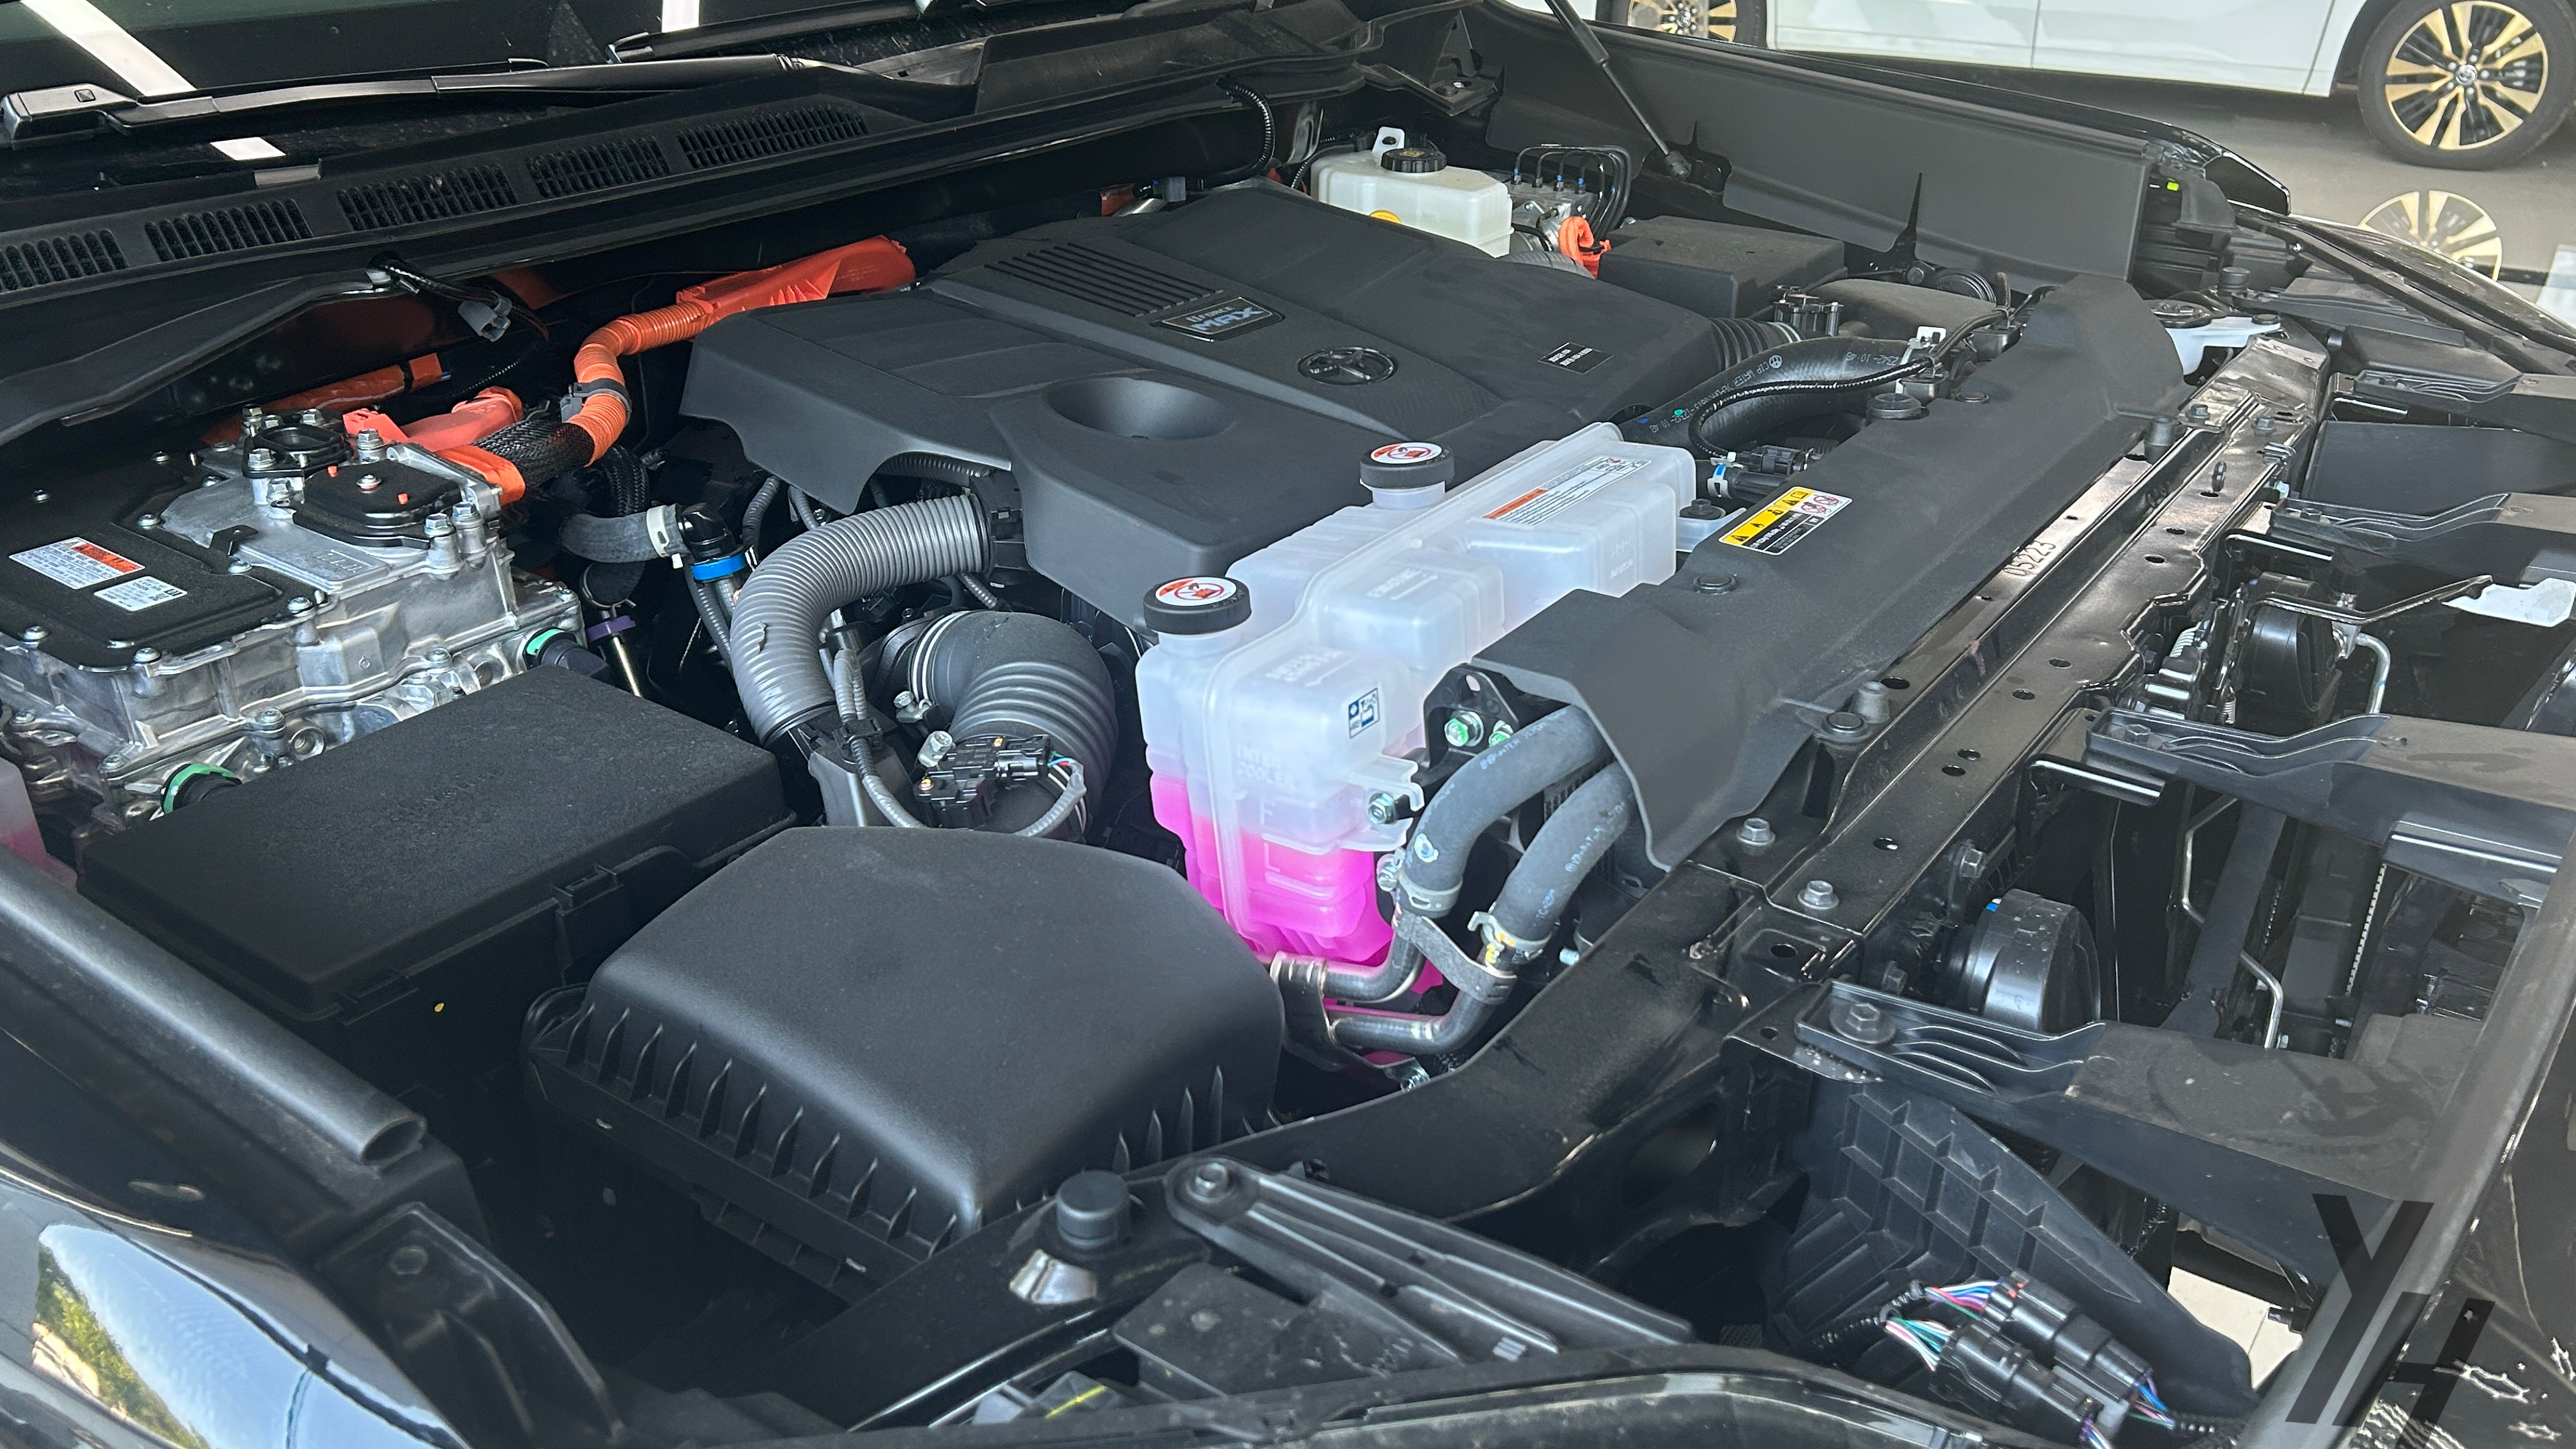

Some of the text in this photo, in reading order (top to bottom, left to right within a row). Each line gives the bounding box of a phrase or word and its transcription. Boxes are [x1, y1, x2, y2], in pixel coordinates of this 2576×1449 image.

[1190, 307, 1264, 332] MAX
[1237, 760, 1297, 792] COOLER
[1260, 799, 1276, 826] F
